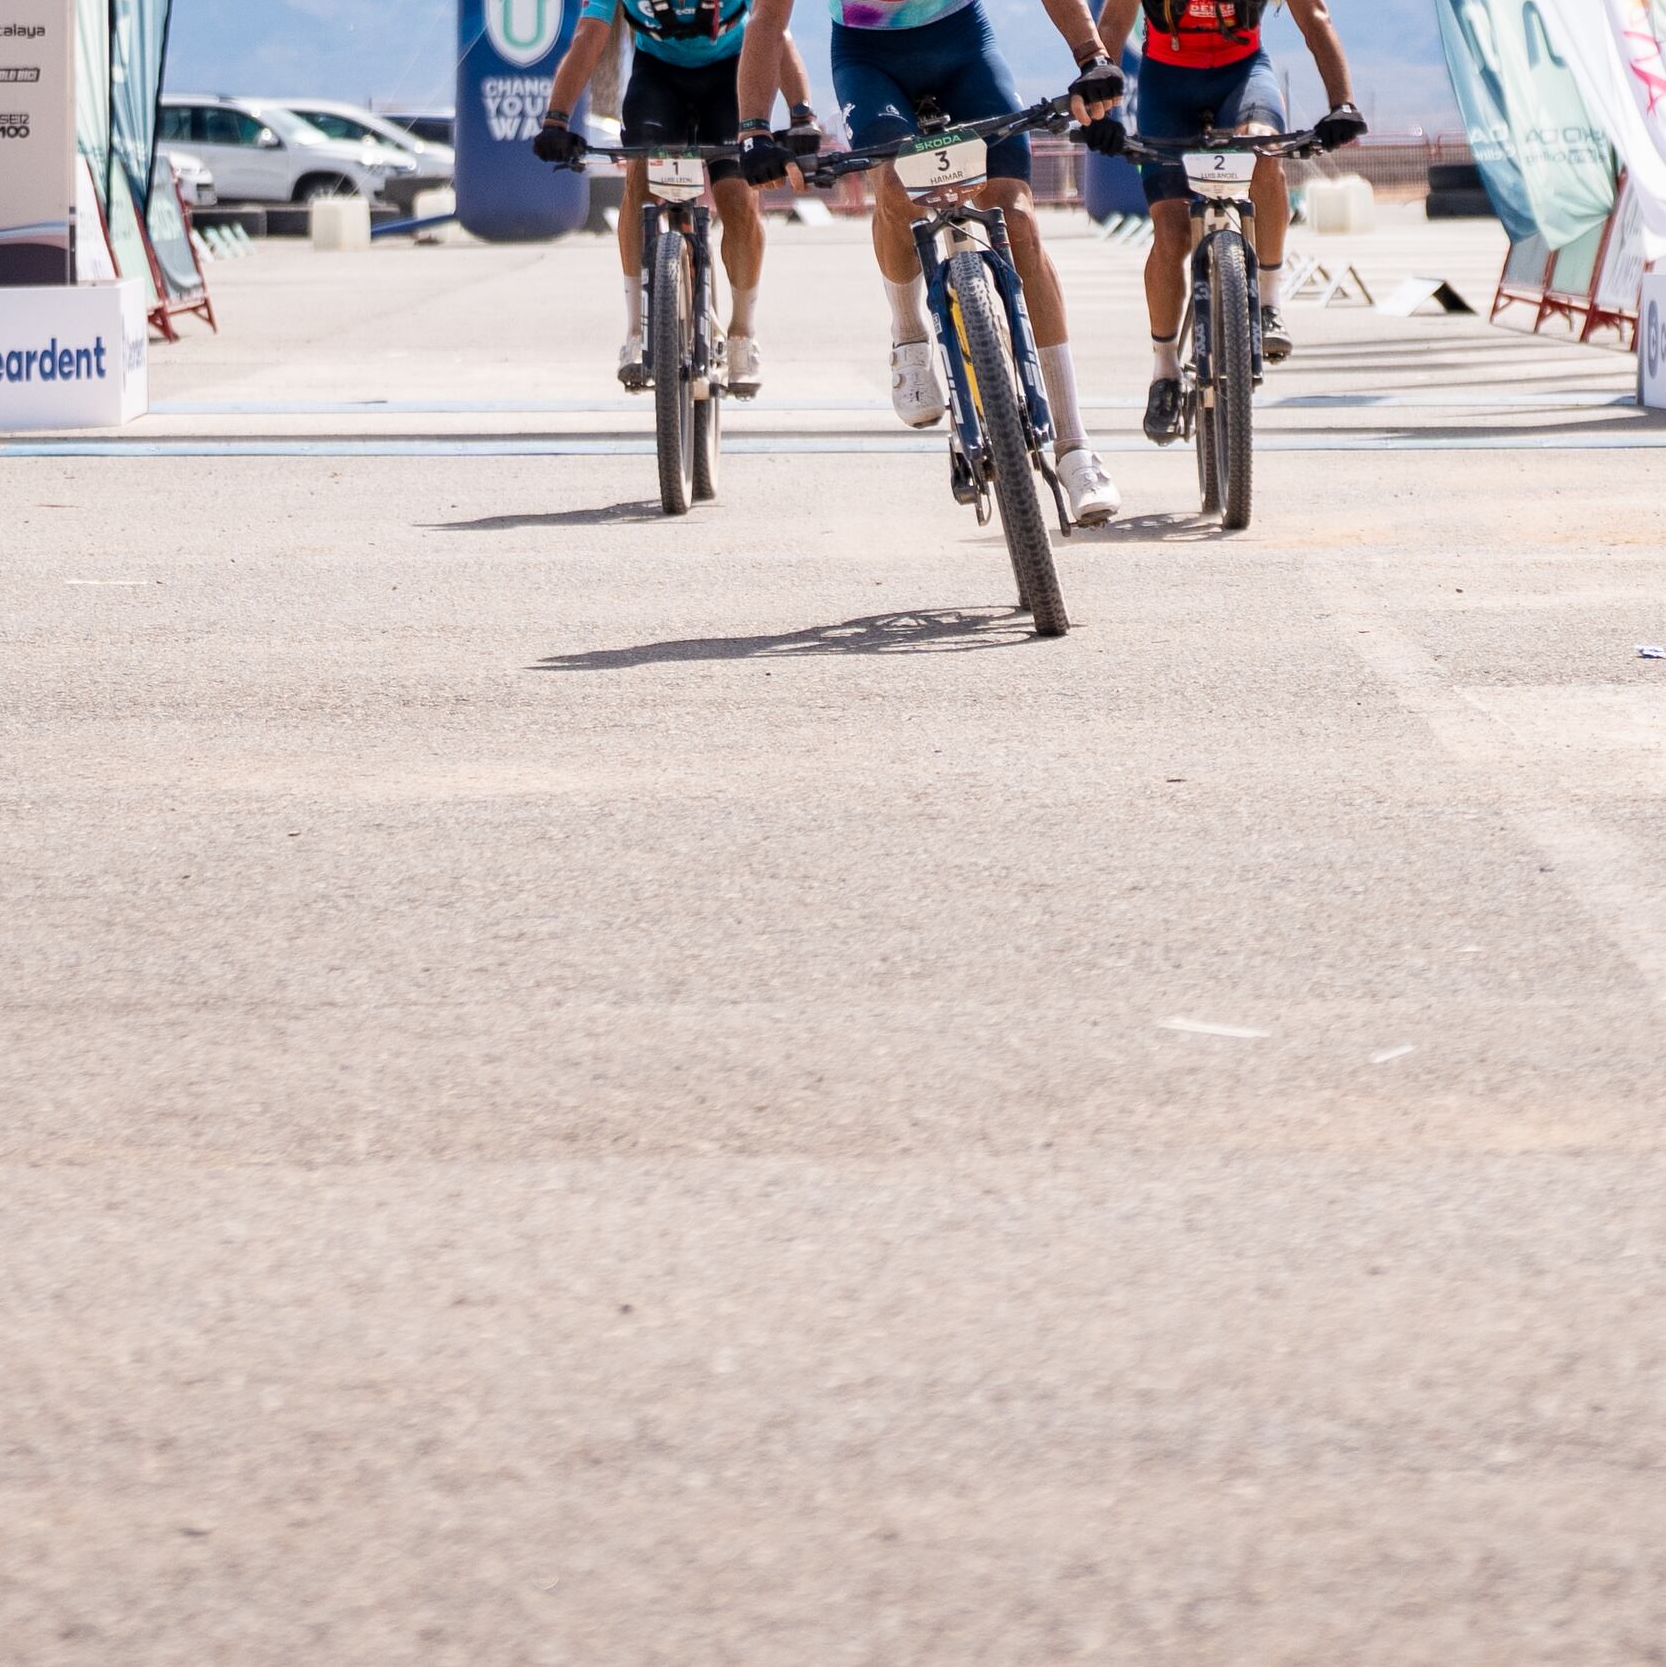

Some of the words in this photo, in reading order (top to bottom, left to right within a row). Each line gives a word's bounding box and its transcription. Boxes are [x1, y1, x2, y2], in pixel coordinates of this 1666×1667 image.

[0, 125, 31, 139] 100
[672, 160, 680, 176] 1
[934, 150, 950, 172] 3
[1213, 155, 1225, 170] 2
[930, 170, 964, 184] HAIMAR
